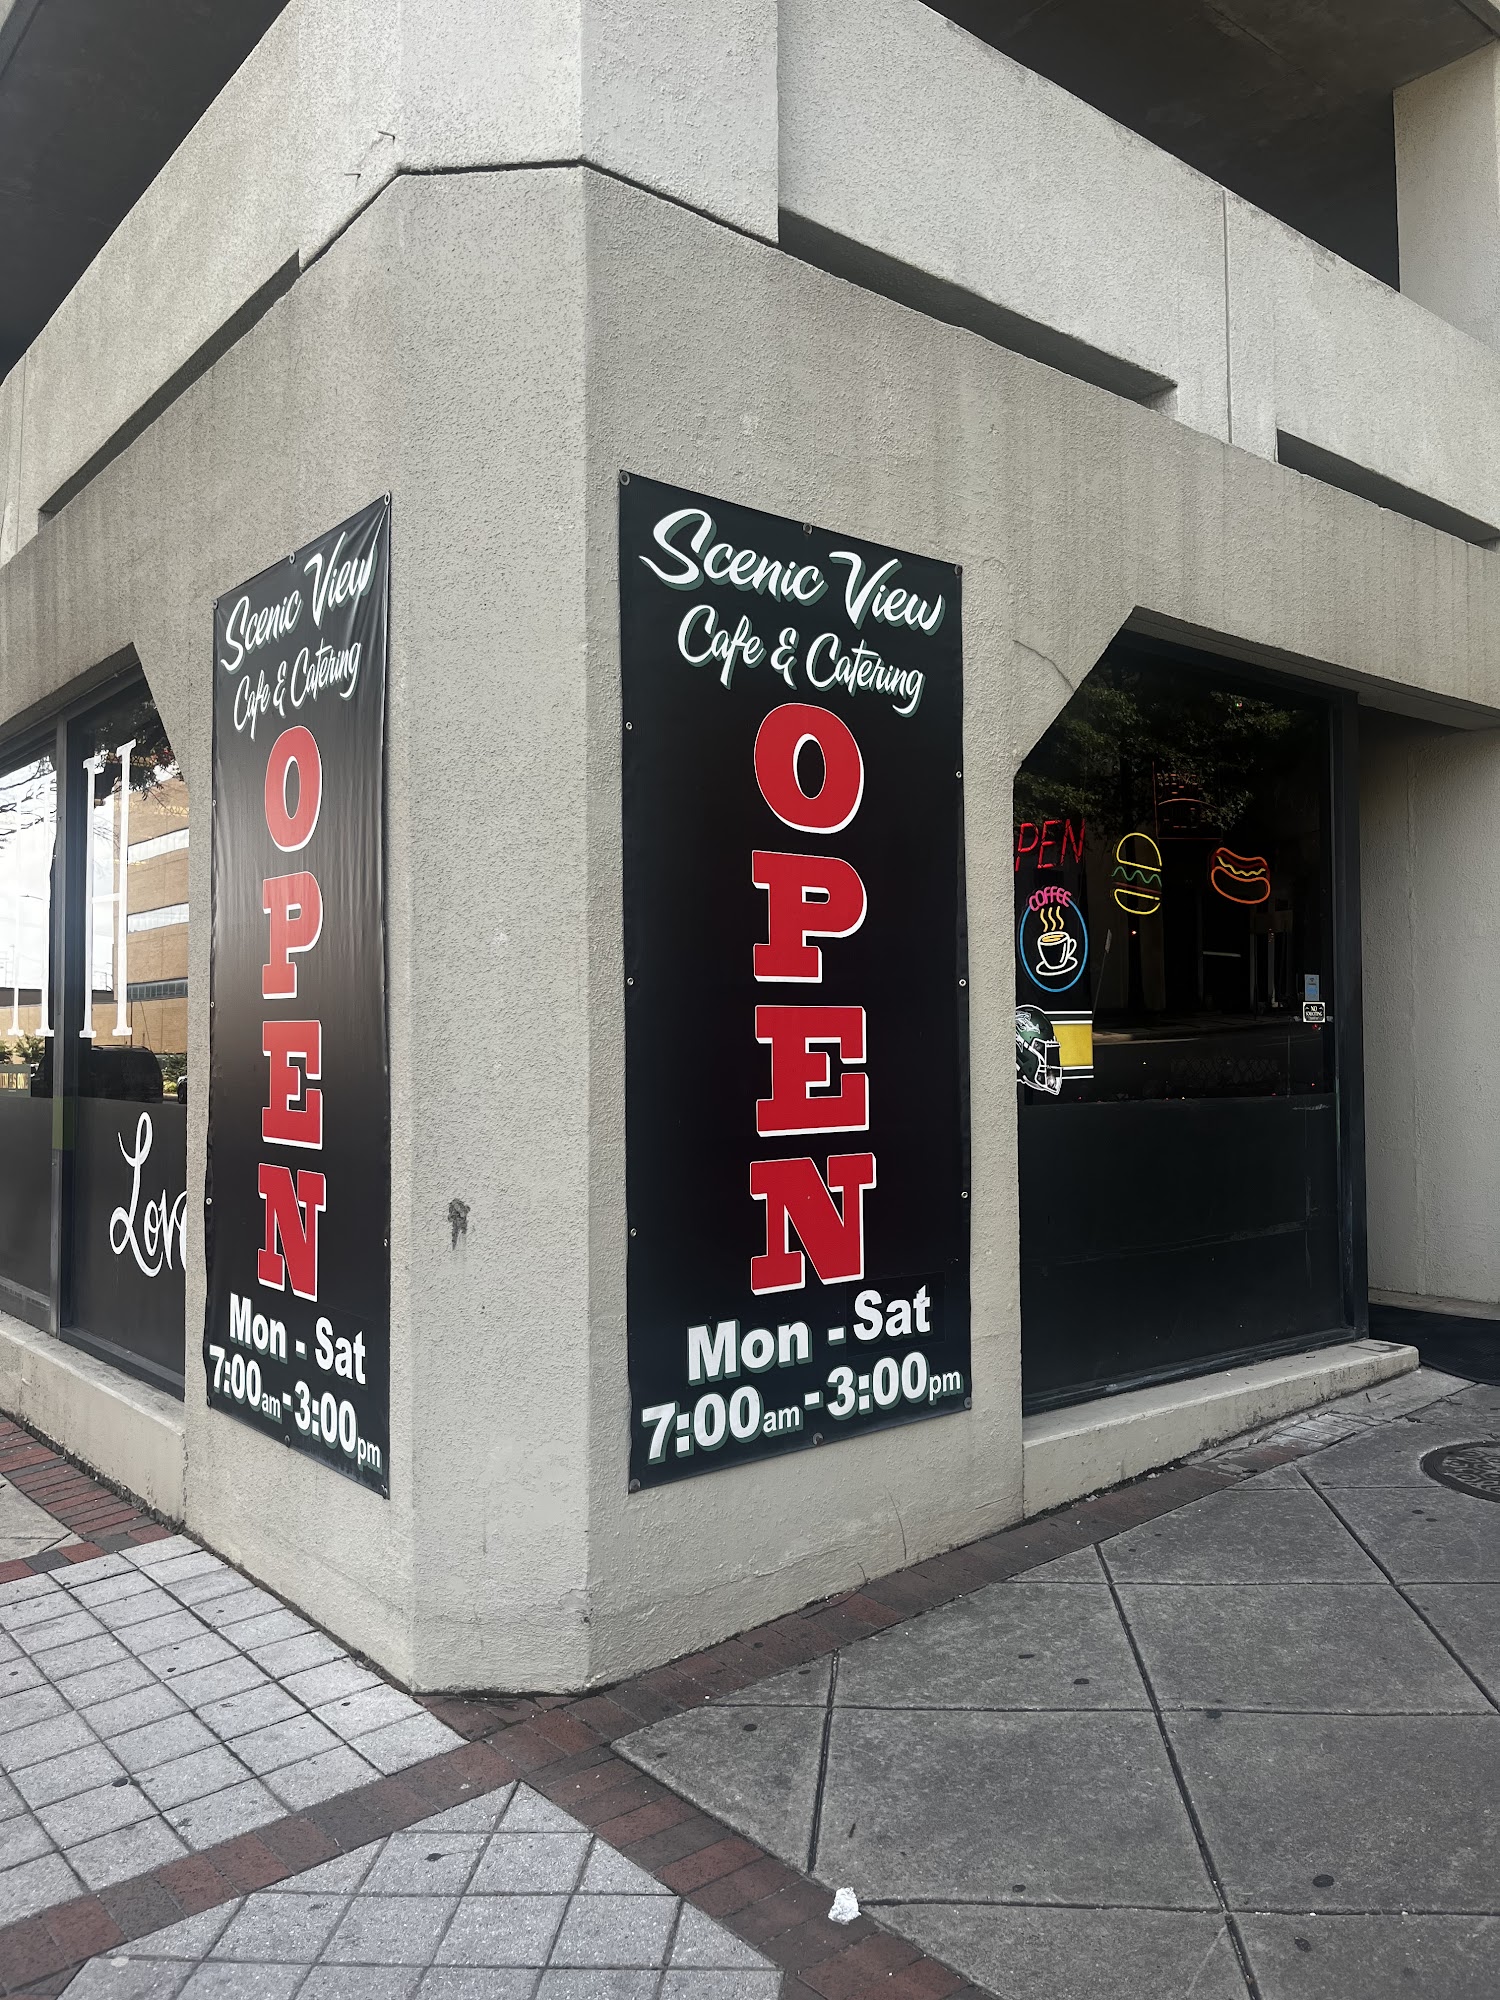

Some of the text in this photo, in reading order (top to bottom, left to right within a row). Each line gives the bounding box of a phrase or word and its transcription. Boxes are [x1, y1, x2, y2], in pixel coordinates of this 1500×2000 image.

[221, 531, 375, 671] Scenic View
[639, 508, 943, 631] Scenic View
[234, 638, 361, 740] Cafe & Catering
[678, 604, 924, 714] Cafe & Catering
[1014, 819, 1086, 872] PEN
[1029, 886, 1072, 911] COFFEE
[258, 725, 326, 1302] OPEN
[750, 703, 876, 1295] OPEN
[229, 1292, 287, 1359] Mon
[315, 1316, 366, 1385] Sat
[688, 1320, 809, 1381] Mon
[853, 1285, 931, 1341] Sat
